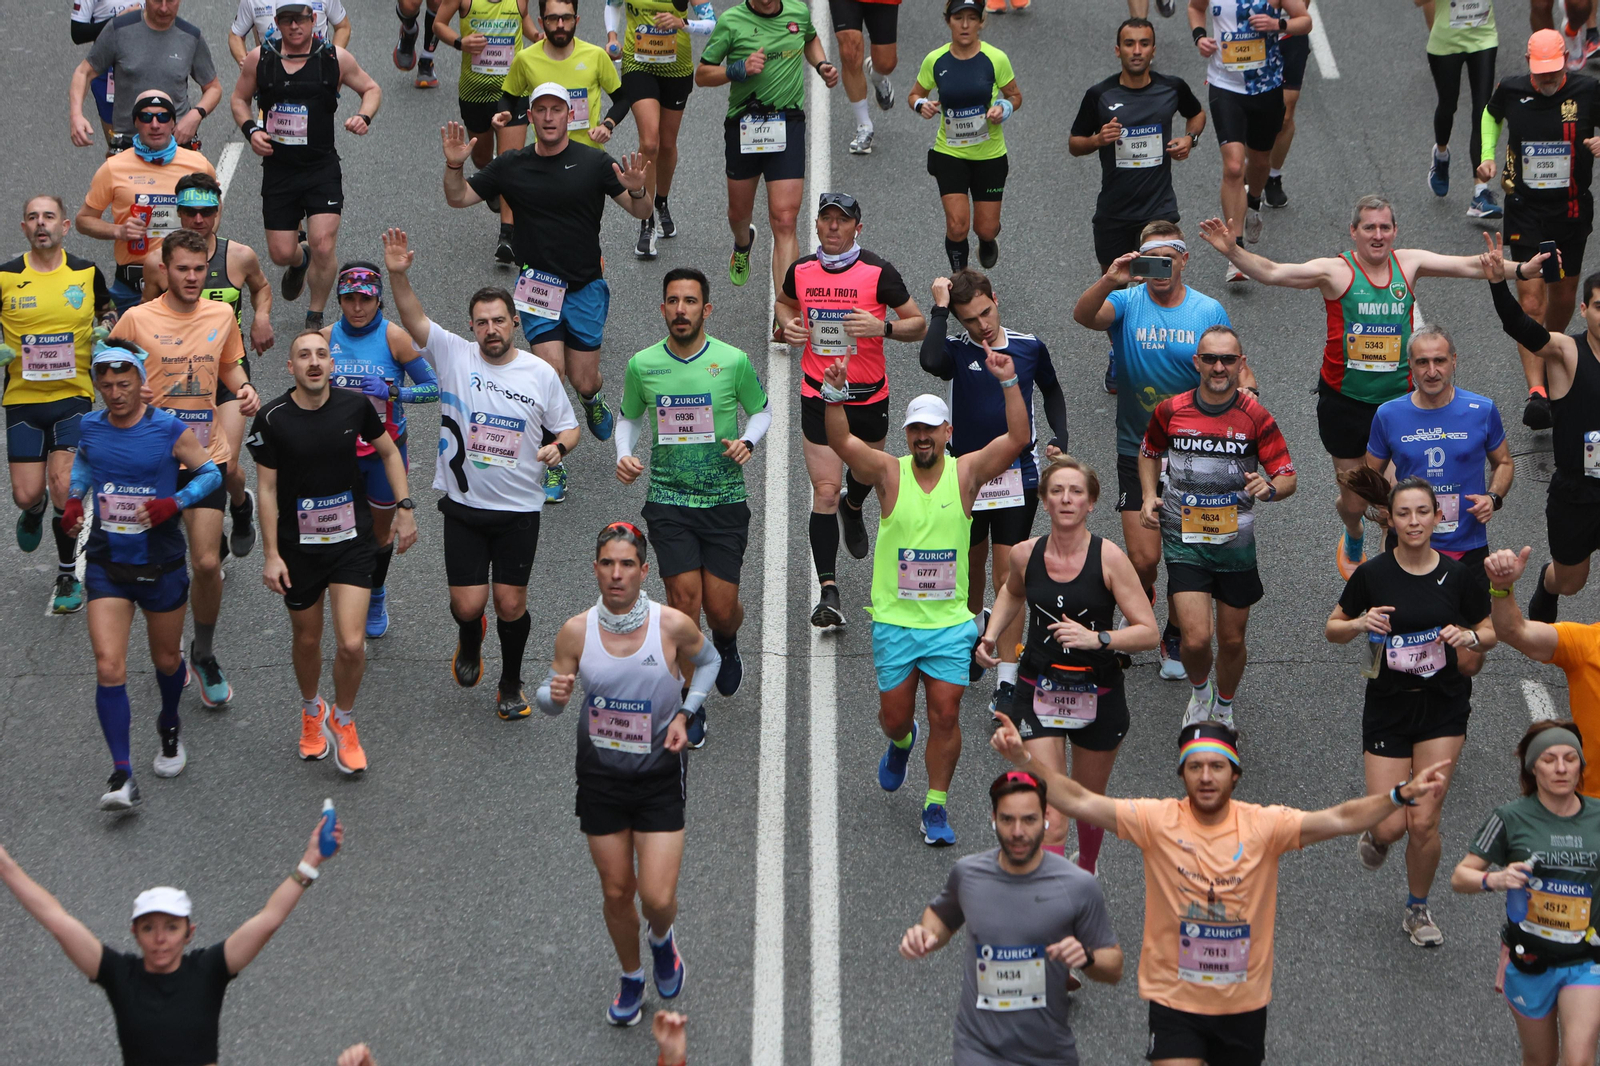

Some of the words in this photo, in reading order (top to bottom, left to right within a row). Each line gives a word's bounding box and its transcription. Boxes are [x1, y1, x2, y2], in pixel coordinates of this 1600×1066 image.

[471, 19, 517, 28] CHIANCHIA
[1234, 32, 1260, 40] ZURICH
[278, 105, 303, 113] ZURICH
[955, 108, 980, 117] ZURICH
[1131, 127, 1157, 136] ZURICH
[1536, 147, 1565, 155] ZURICH
[535, 272, 562, 285] ZURICH
[532, 286, 549, 297] 6934
[805, 288, 831, 297] PUCELA
[834, 288, 858, 298] TROTA
[527, 296, 549, 308] BRANKO
[1358, 302, 1389, 315] MAYO
[1391, 302, 1405, 315] AC
[821, 326, 839, 335] 8626
[1366, 326, 1396, 334] ZURICH
[38, 334, 68, 343] ZURICH
[1136, 325, 1195, 345] MÁRTON
[1142, 342, 1165, 350] TEAM
[1365, 341, 1384, 350] 5343
[39, 350, 58, 359] 7922
[161, 355, 188, 363] Maratón
[193, 354, 215, 363] Sevilla
[49, 361, 71, 369] TRIANA
[675, 397, 705, 405] ZURICH
[180, 412, 208, 420] ZURICH
[675, 413, 695, 421] 6936
[489, 418, 520, 429] ZURICH
[1416, 427, 1443, 435] CLUB
[486, 432, 506, 443] 7507
[1401, 432, 1468, 443] CORREDRES
[471, 442, 486, 451] ÁLEX
[487, 446, 515, 457] REPSCAN
[1173, 438, 1249, 455] HUNGARY
[1424, 446, 1446, 468] 10
[117, 486, 150, 494] ZURICH
[1432, 484, 1453, 492] RICH
[980, 489, 1010, 498] VERDUGO
[317, 495, 347, 507] ZURICH
[1200, 498, 1231, 506] ZURICH
[116, 502, 136, 511] 7530
[318, 513, 338, 523] 6660
[1200, 513, 1220, 522] 4634
[316, 524, 342, 533] MAXIME
[1202, 526, 1220, 534] KOKO
[918, 552, 950, 560] ZURICH
[917, 569, 937, 577] 6777
[1057, 595, 1064, 608] S
[1407, 631, 1438, 644] ZURICH
[1408, 651, 1427, 662] 7778
[1054, 697, 1076, 705] 6418
[609, 701, 644, 711] ZURICH
[1058, 709, 1071, 717] ELS
[609, 717, 630, 728] 7869
[597, 729, 613, 738] HIJO
[624, 732, 643, 741] JUAN
[1534, 851, 1598, 868] FINISHER
[1546, 881, 1585, 895] ZURICH
[1543, 902, 1568, 914] 4512
[1536, 916, 1571, 930] VIRGINIA
[1204, 927, 1241, 938] ZURICH
[996, 949, 1035, 960] ZURICH
[1202, 946, 1227, 958] 7613
[1198, 962, 1229, 971] TORRES
